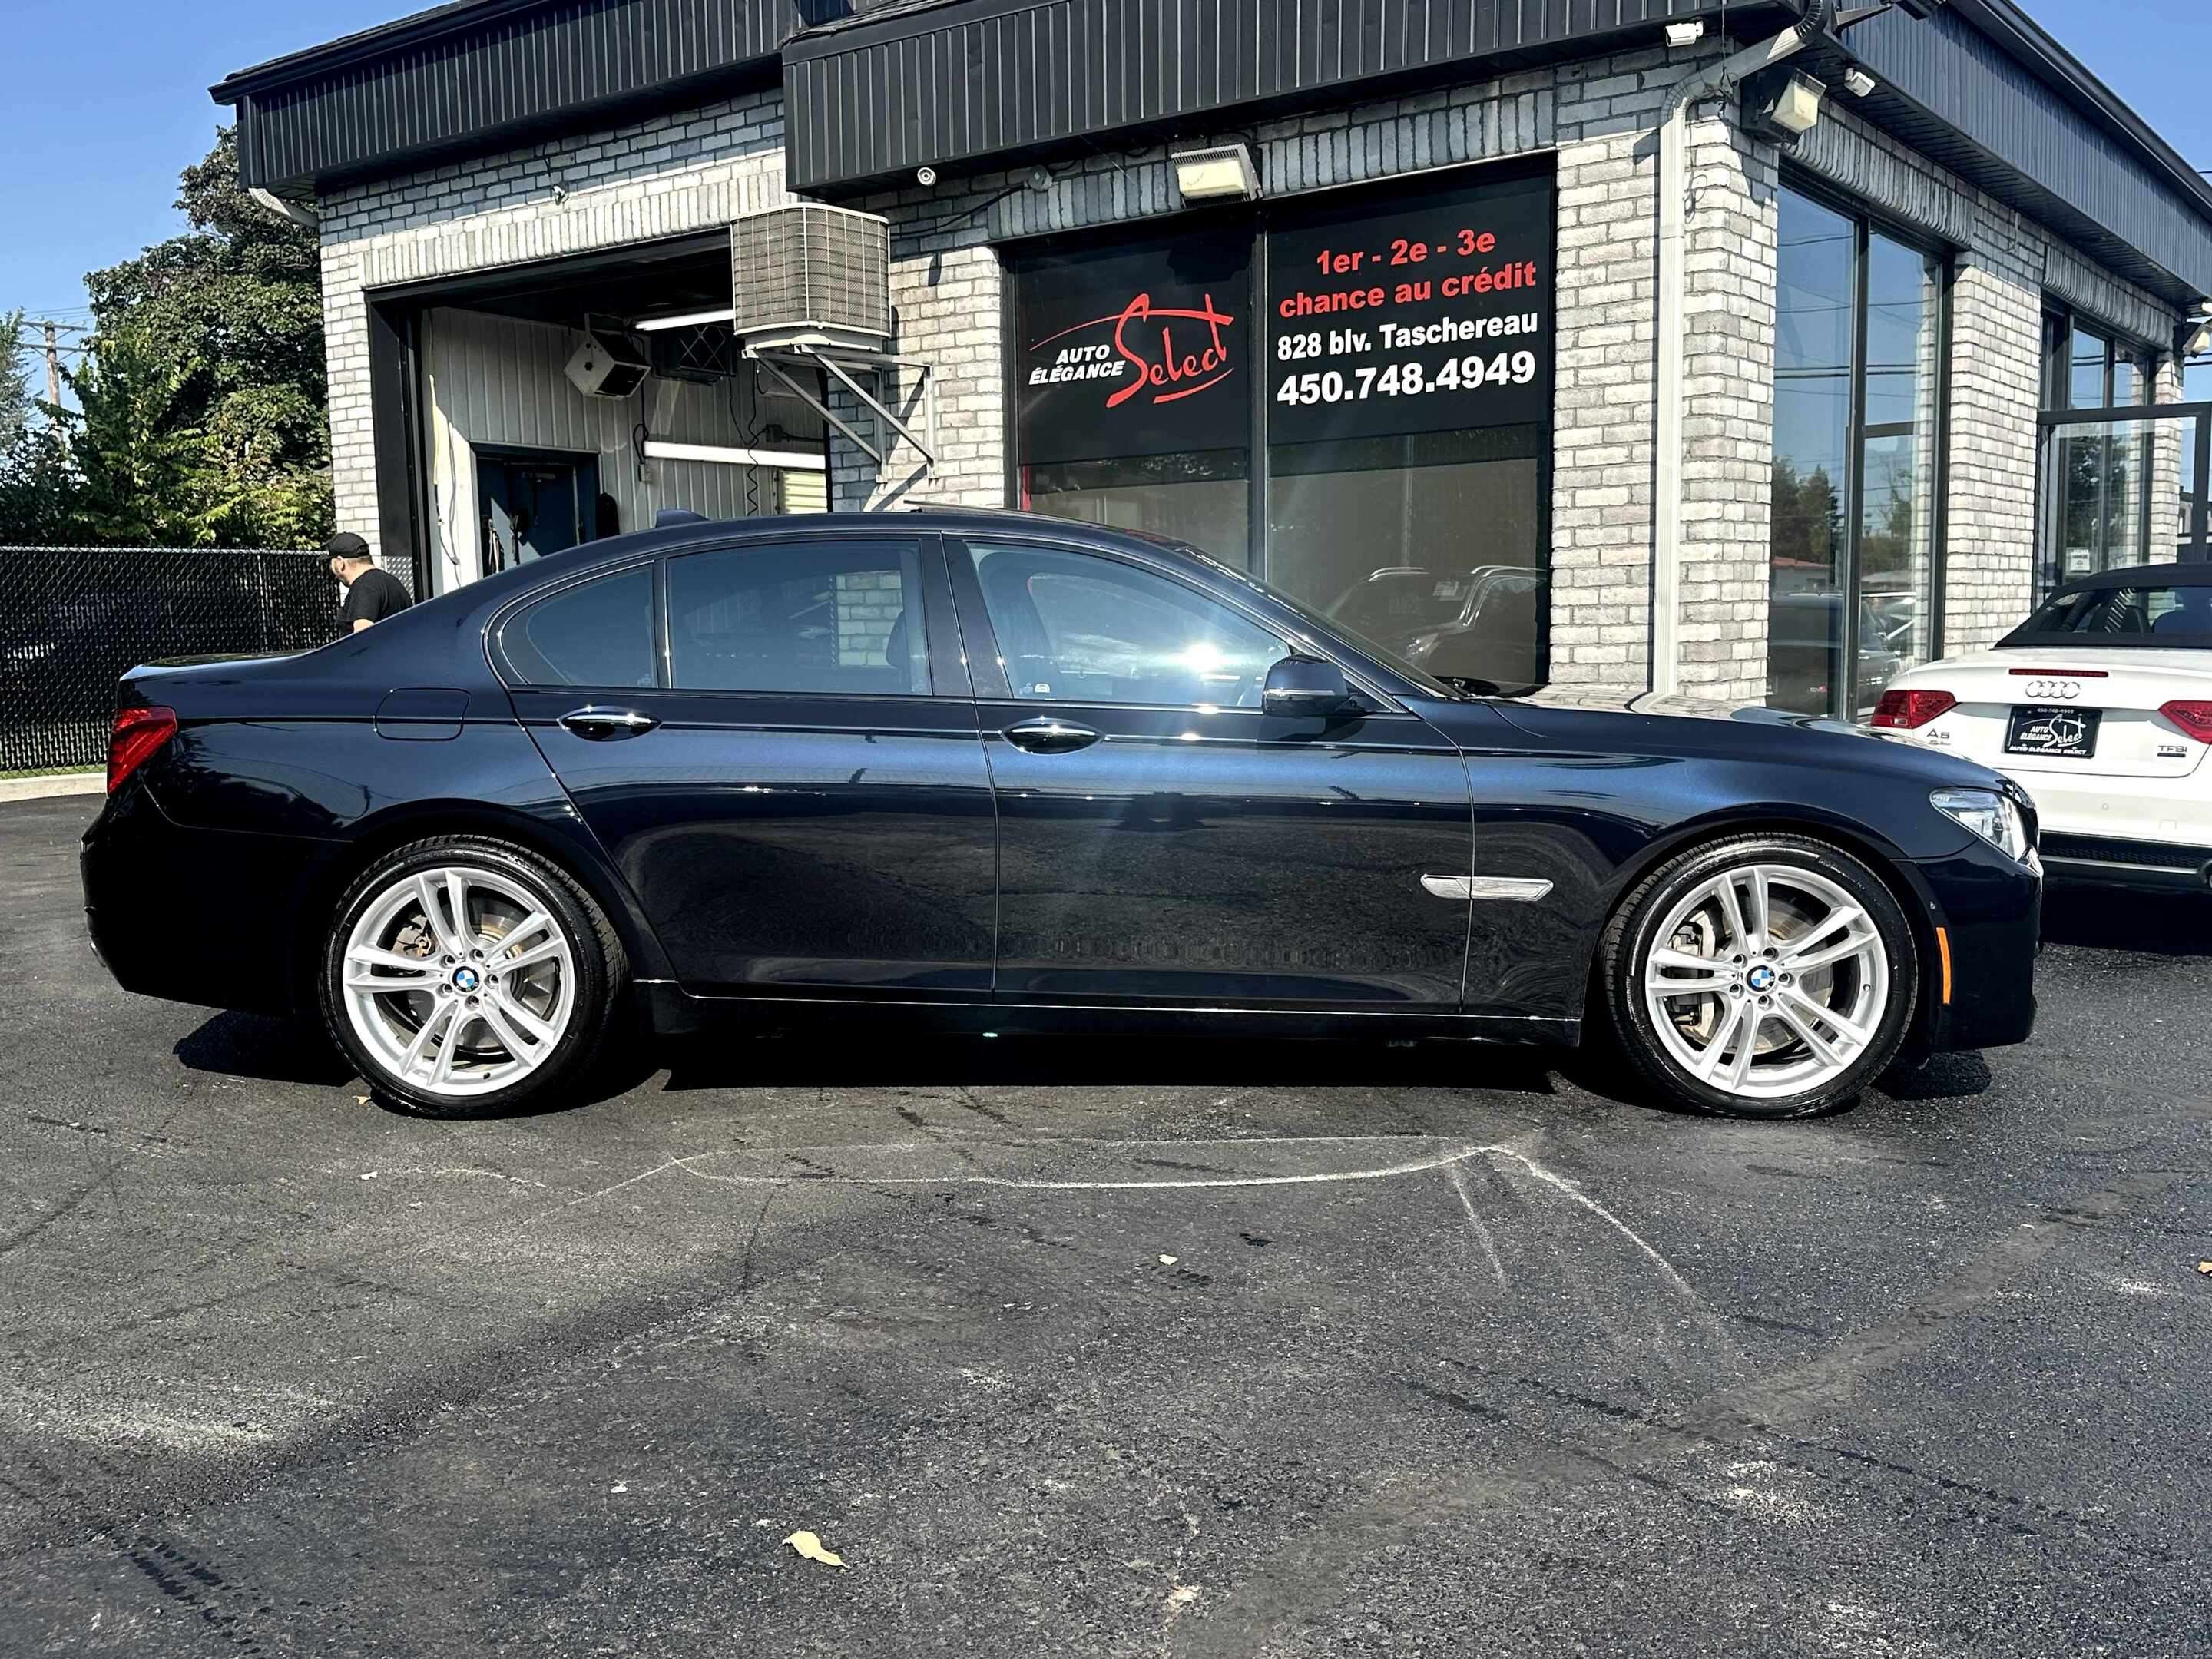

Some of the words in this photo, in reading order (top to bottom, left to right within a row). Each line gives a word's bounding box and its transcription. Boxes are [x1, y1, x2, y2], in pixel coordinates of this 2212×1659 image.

[1317, 250, 1363, 274] 1er
[1391, 239, 1427, 265] 2e
[1457, 230, 1495, 256] 3e
[1279, 287, 1385, 318] chance
[1395, 281, 1431, 303] au
[1441, 262, 1536, 296] crédit
[1055, 344, 1111, 365] AUTO
[1106, 293, 1234, 408] Select
[1277, 332, 1322, 361] 828
[1330, 328, 1372, 356] blv.
[1379, 312, 1538, 349] Taschereau
[1028, 359, 1126, 386] ÉLÉGANCE
[1277, 350, 1535, 406] 450.748.4949
